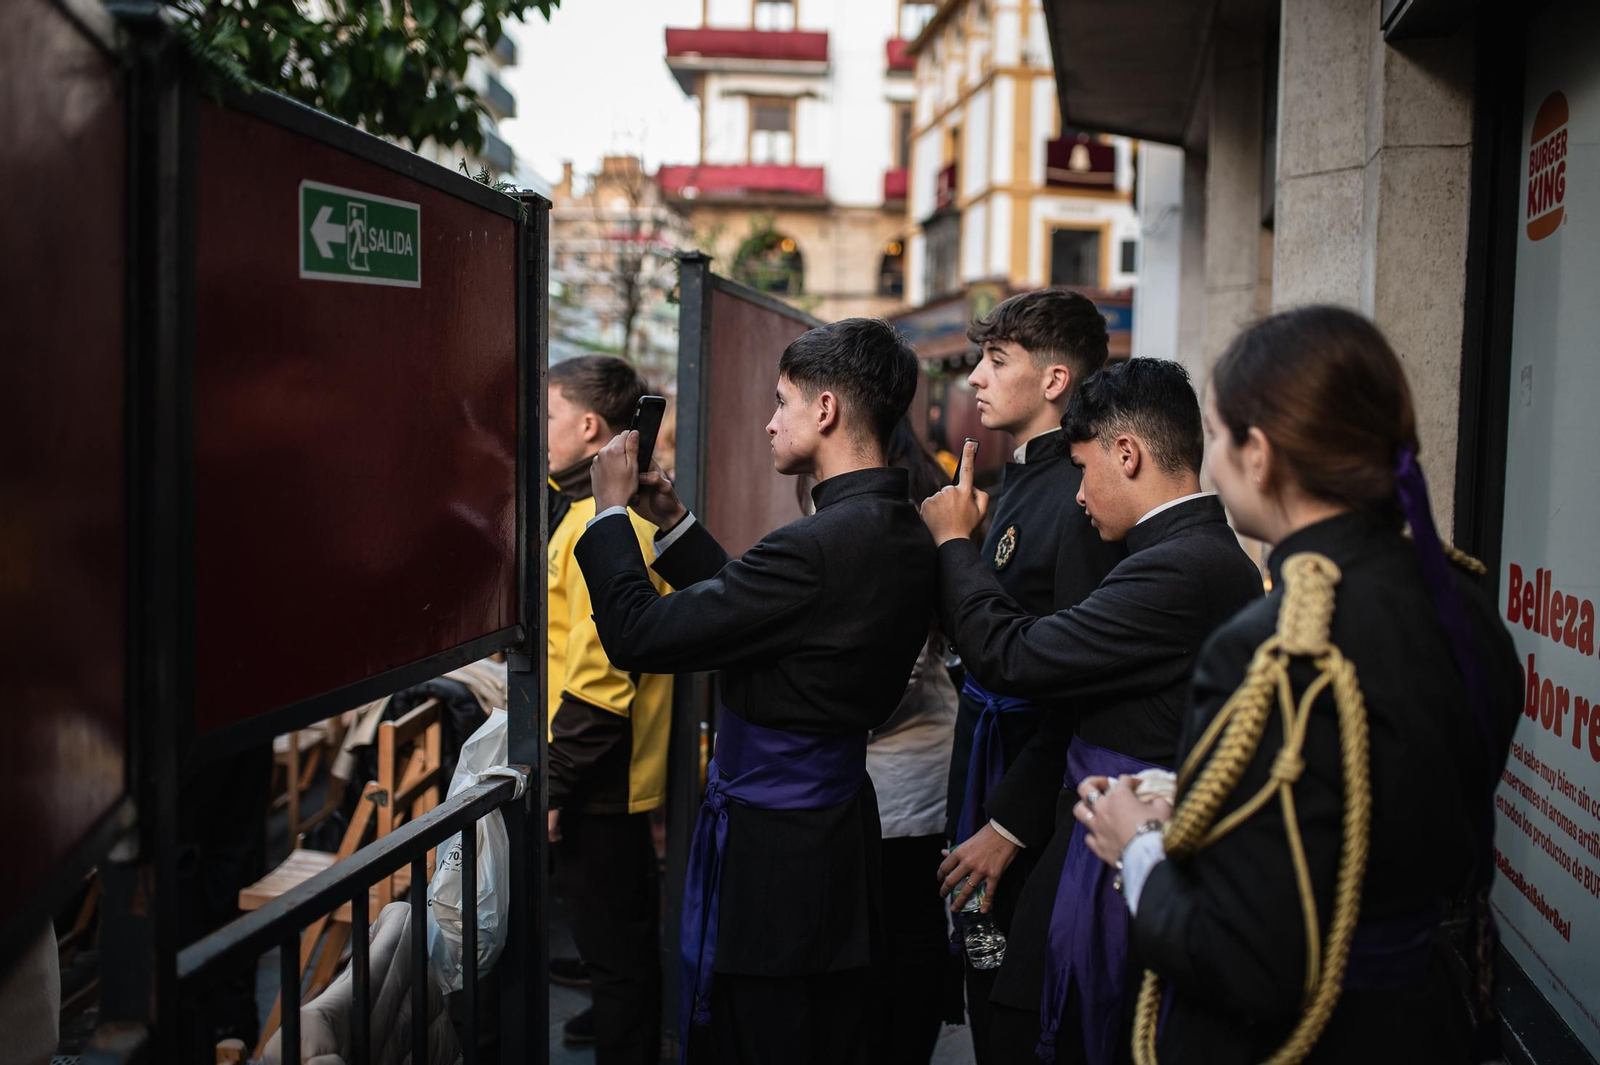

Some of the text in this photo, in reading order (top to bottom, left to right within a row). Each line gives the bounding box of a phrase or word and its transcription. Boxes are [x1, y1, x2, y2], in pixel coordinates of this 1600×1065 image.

[1529, 127, 1568, 178] BURGER
[1527, 160, 1566, 219] KING
[368, 226, 413, 256] SALIDA
[1507, 562, 1594, 656] Belleza
[1524, 750, 1540, 773] sabe
[1541, 764, 1557, 791] muy
[1557, 769, 1577, 802] bien:
[1578, 786, 1590, 812] sin
[1496, 794, 1505, 811] en
[1504, 799, 1522, 828] todos
[1522, 812, 1533, 837] los
[1533, 825, 1571, 873] productos
[1572, 857, 1583, 883] de
[1541, 795, 1549, 817] ni
[1549, 804, 1577, 840] aromas
